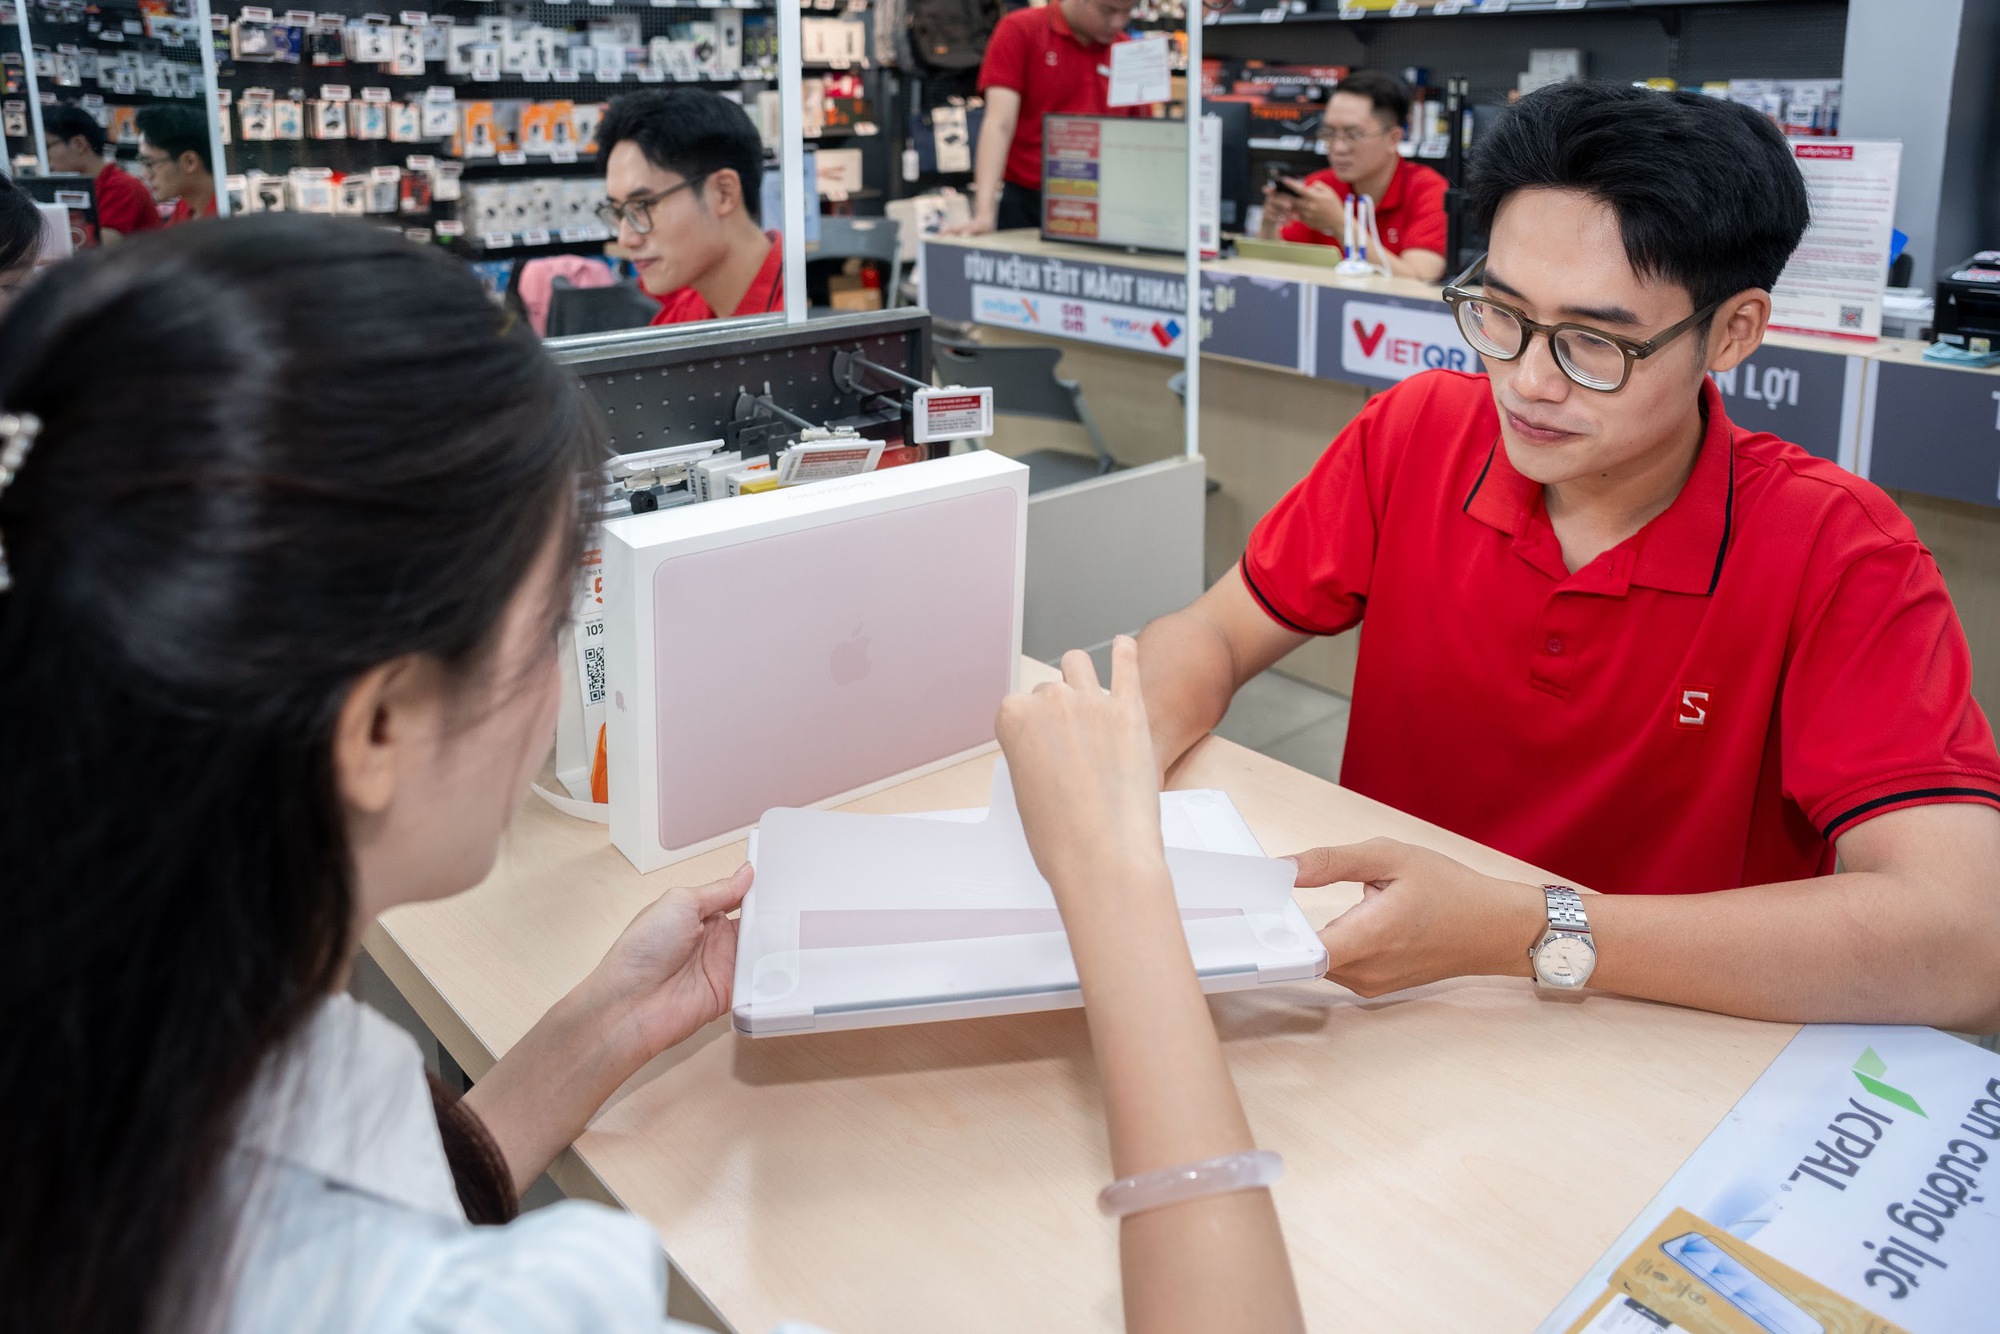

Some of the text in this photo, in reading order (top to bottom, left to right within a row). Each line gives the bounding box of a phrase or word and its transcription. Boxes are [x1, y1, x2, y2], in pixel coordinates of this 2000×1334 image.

[1744, 363, 1800, 411] LỢI
[1886, 1138, 1988, 1244] cường
[1862, 1235, 1948, 1300] lực
